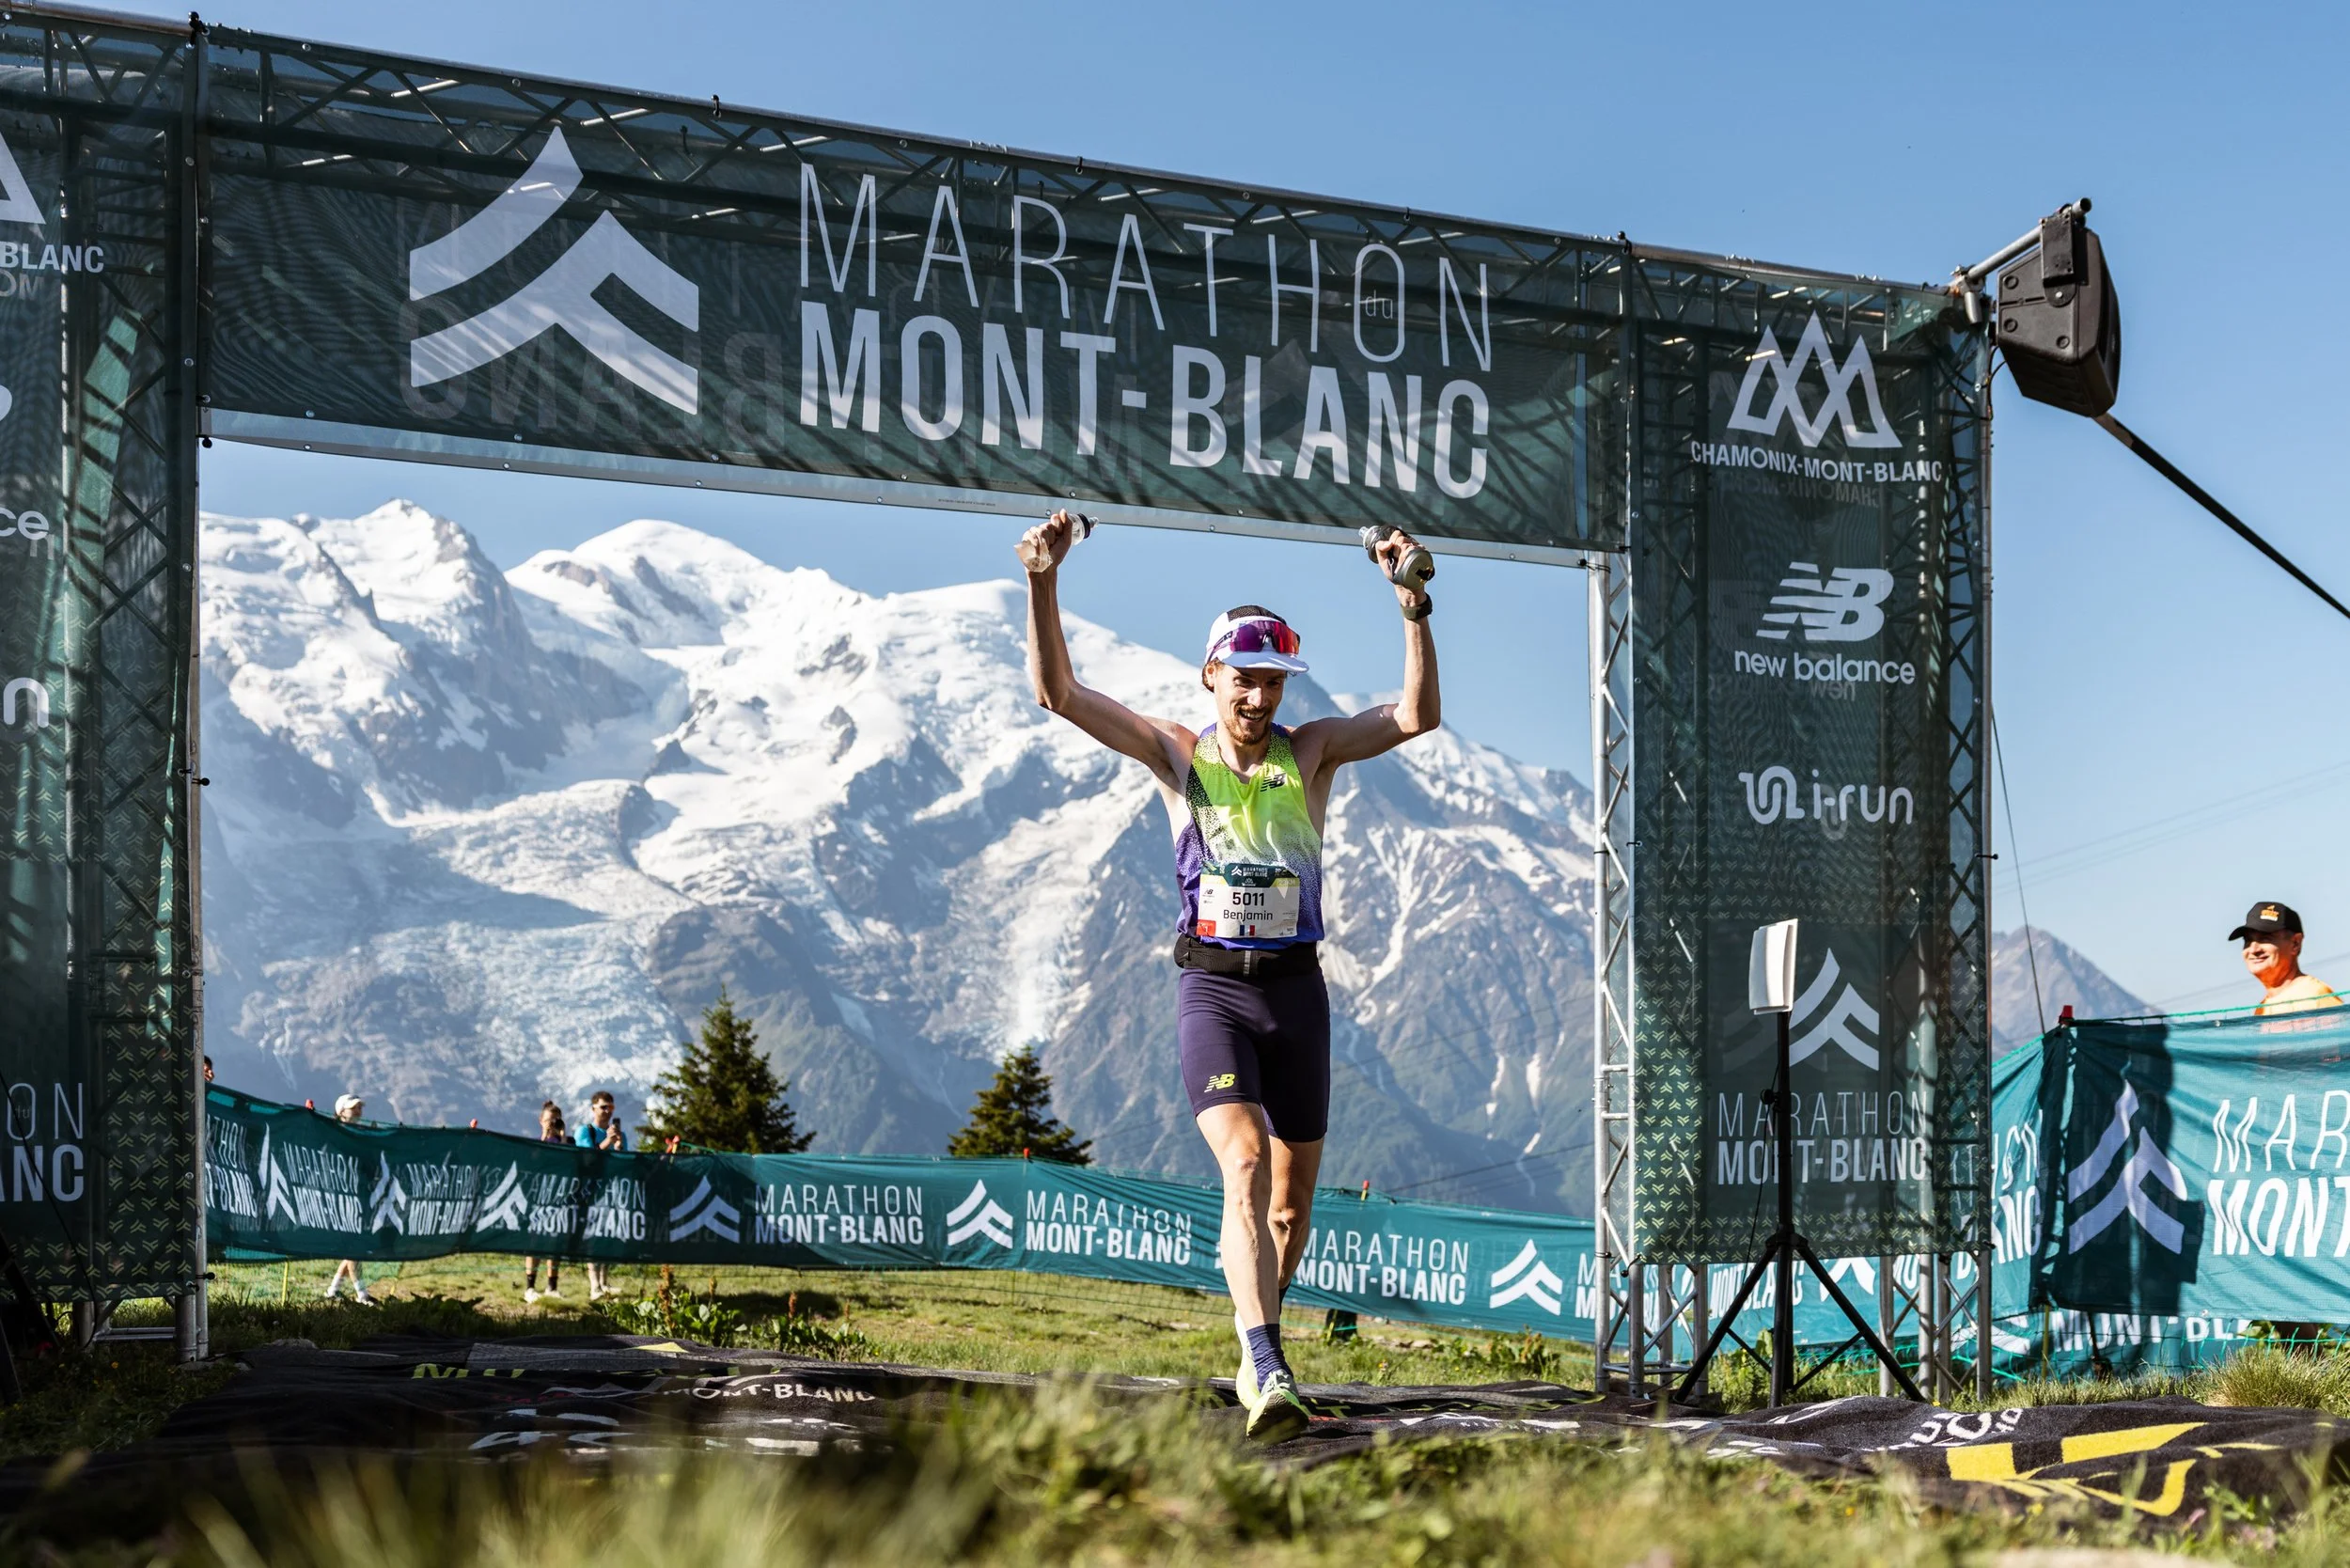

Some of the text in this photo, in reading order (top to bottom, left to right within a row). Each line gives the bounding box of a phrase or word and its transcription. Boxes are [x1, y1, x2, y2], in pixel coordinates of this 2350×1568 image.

[801, 163, 1492, 371] MARATHON
[800, 301, 1490, 499] MONT-BLANC
[1691, 440, 1942, 482] CHAMONIX-MONT-BLANC
[1734, 650, 1916, 685] new balance
[1812, 770, 1915, 824] i-run
[1223, 909, 1274, 921] Benjamin
[1232, 892, 1265, 906] 5011
[0, 1144, 84, 1201] NC
[284, 1141, 359, 1194] MARATHON
[292, 1185, 363, 1234] MONT-BLANC
[755, 1184, 922, 1215] MARATHON
[1026, 1190, 1192, 1239] MARATHON
[755, 1214, 923, 1245] MONT-BLANC
[1026, 1221, 1191, 1265] MONT-BLANC
[1296, 1259, 1466, 1305] MONT-BLANC
